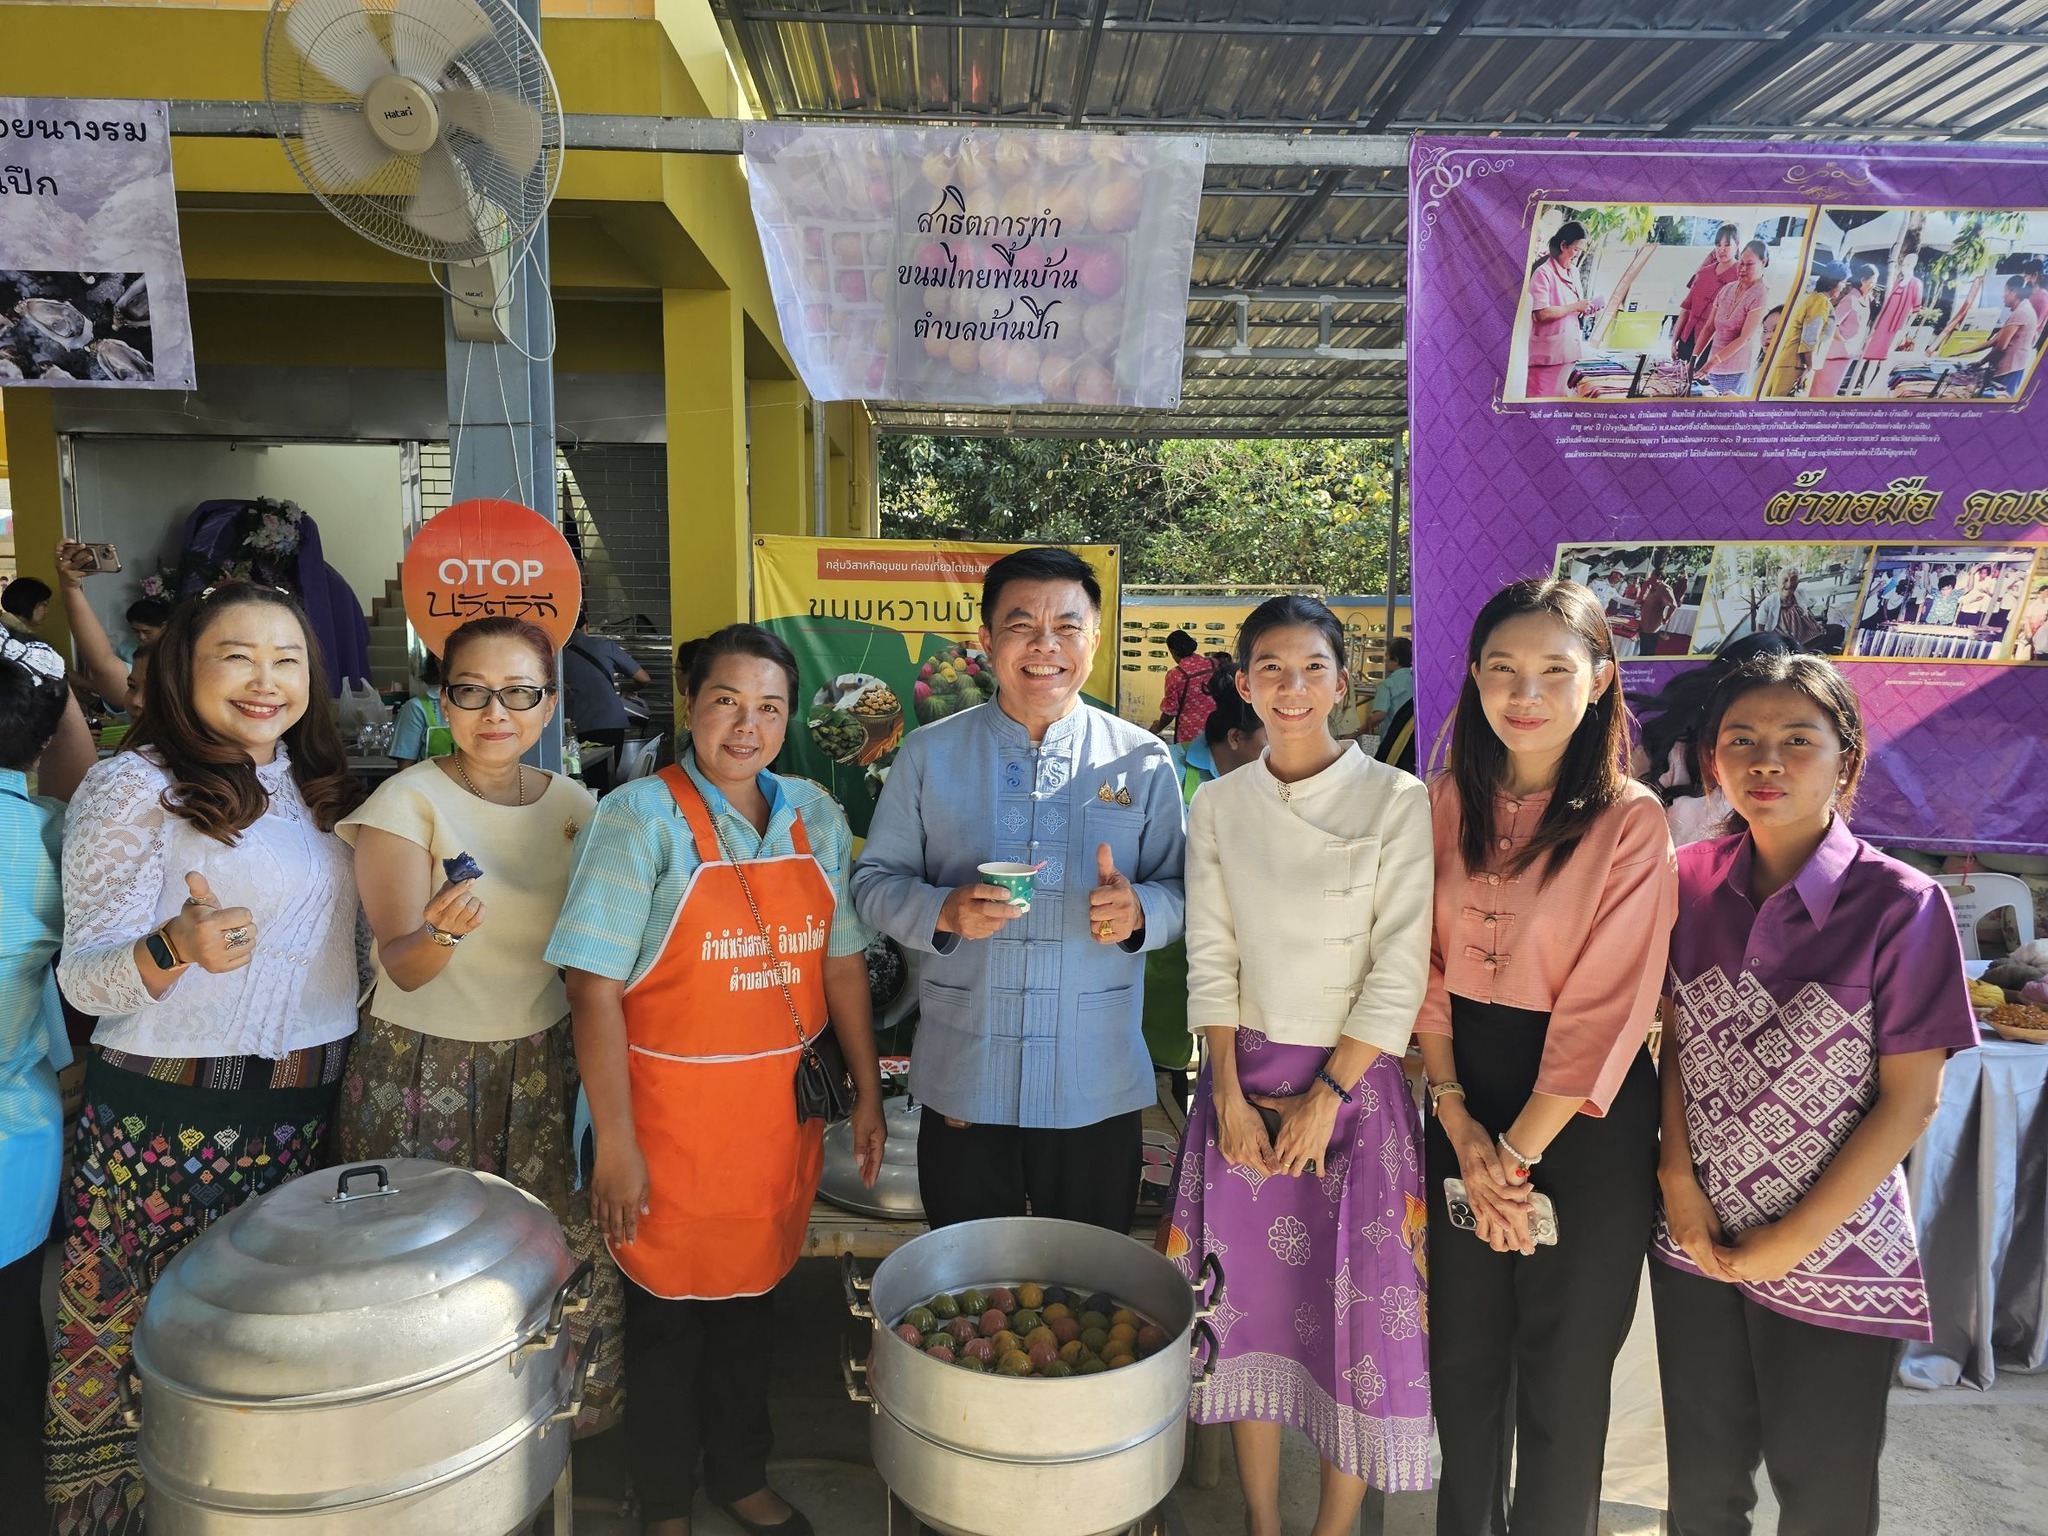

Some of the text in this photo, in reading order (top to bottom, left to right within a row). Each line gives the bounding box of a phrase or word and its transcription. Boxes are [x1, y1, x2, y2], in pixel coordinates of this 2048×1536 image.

[384, 106, 413, 120] Hatari
[917, 185, 1062, 238] สาธิตการทำ
[898, 234, 1079, 289] ขนมไทยพื้นบ้าน
[914, 295, 1063, 341] ตำบลบ้านปึก
[1763, 468, 1944, 526] ผ้าทอมือ
[438, 558, 544, 586] OTOP
[826, 558, 908, 575] กลุ่มวิสาหกิจชุมชน
